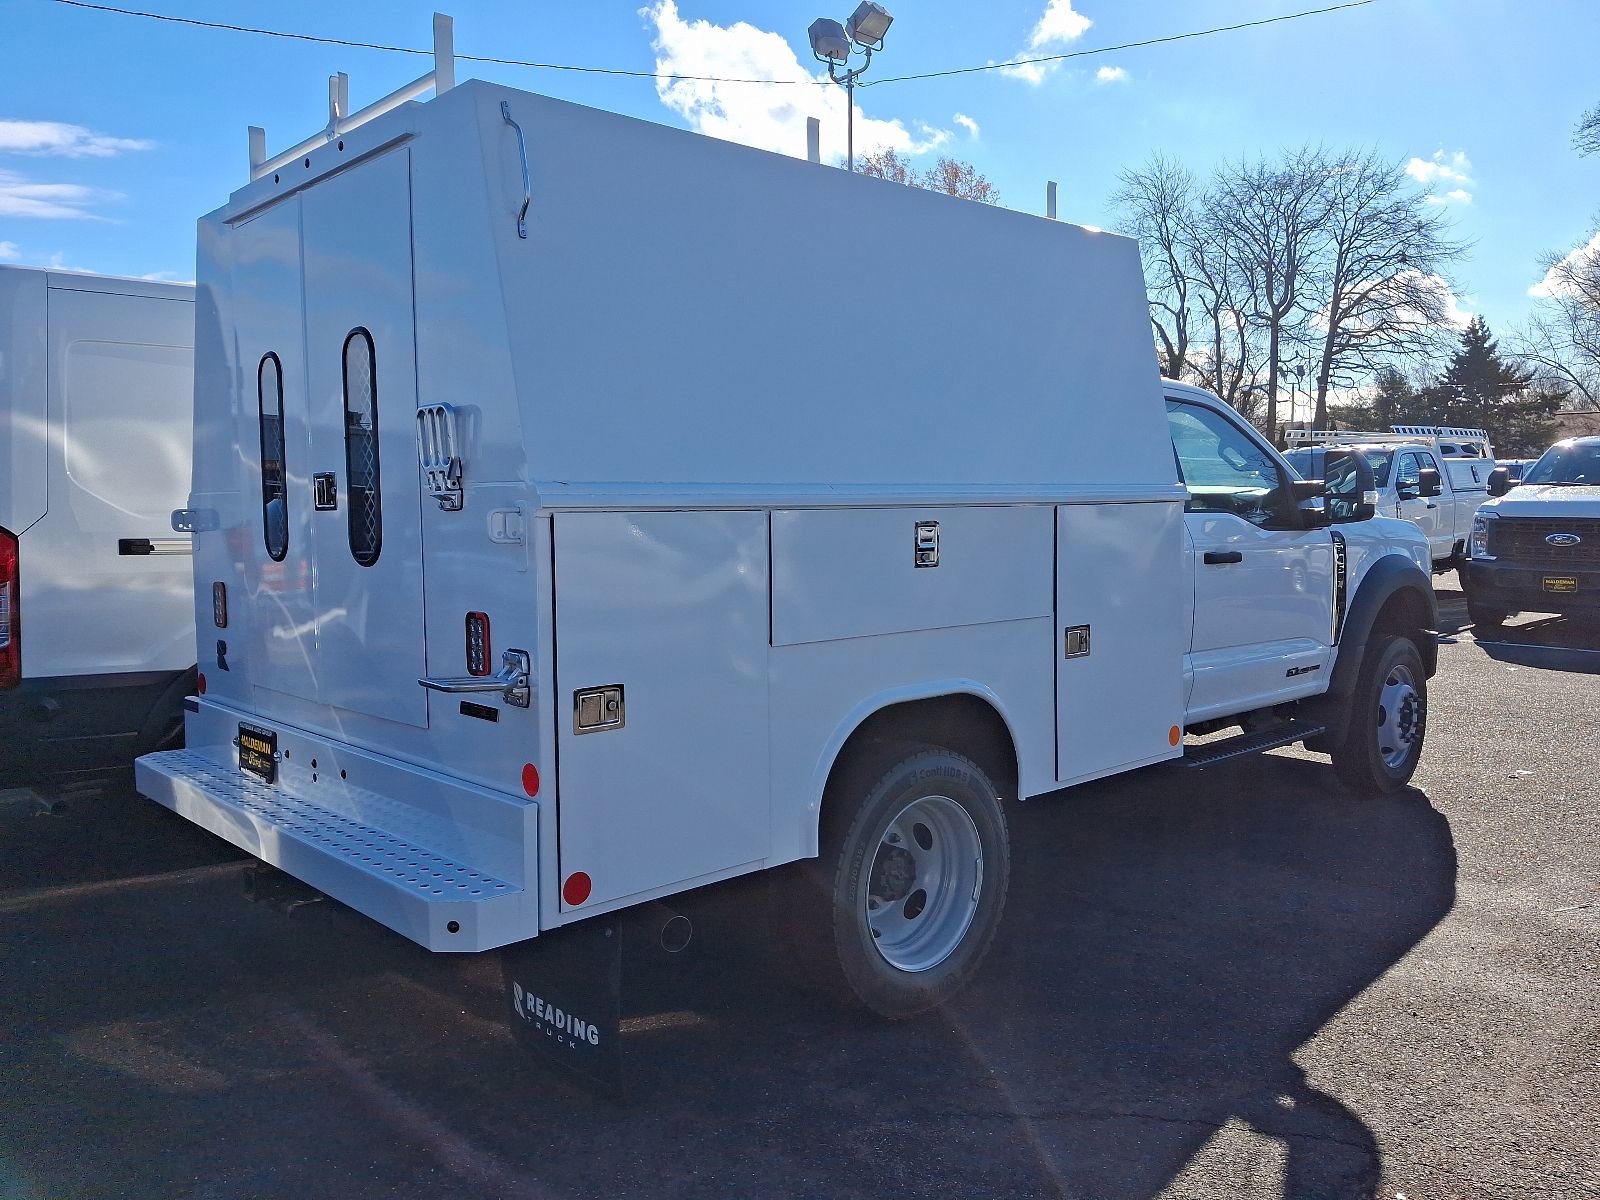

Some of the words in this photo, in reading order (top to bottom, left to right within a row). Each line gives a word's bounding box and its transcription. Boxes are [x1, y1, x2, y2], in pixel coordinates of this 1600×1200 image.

[241, 734, 271, 755] HALDEMAN
[526, 991, 599, 1045] READING
[526, 1016, 575, 1049] TRUCK
